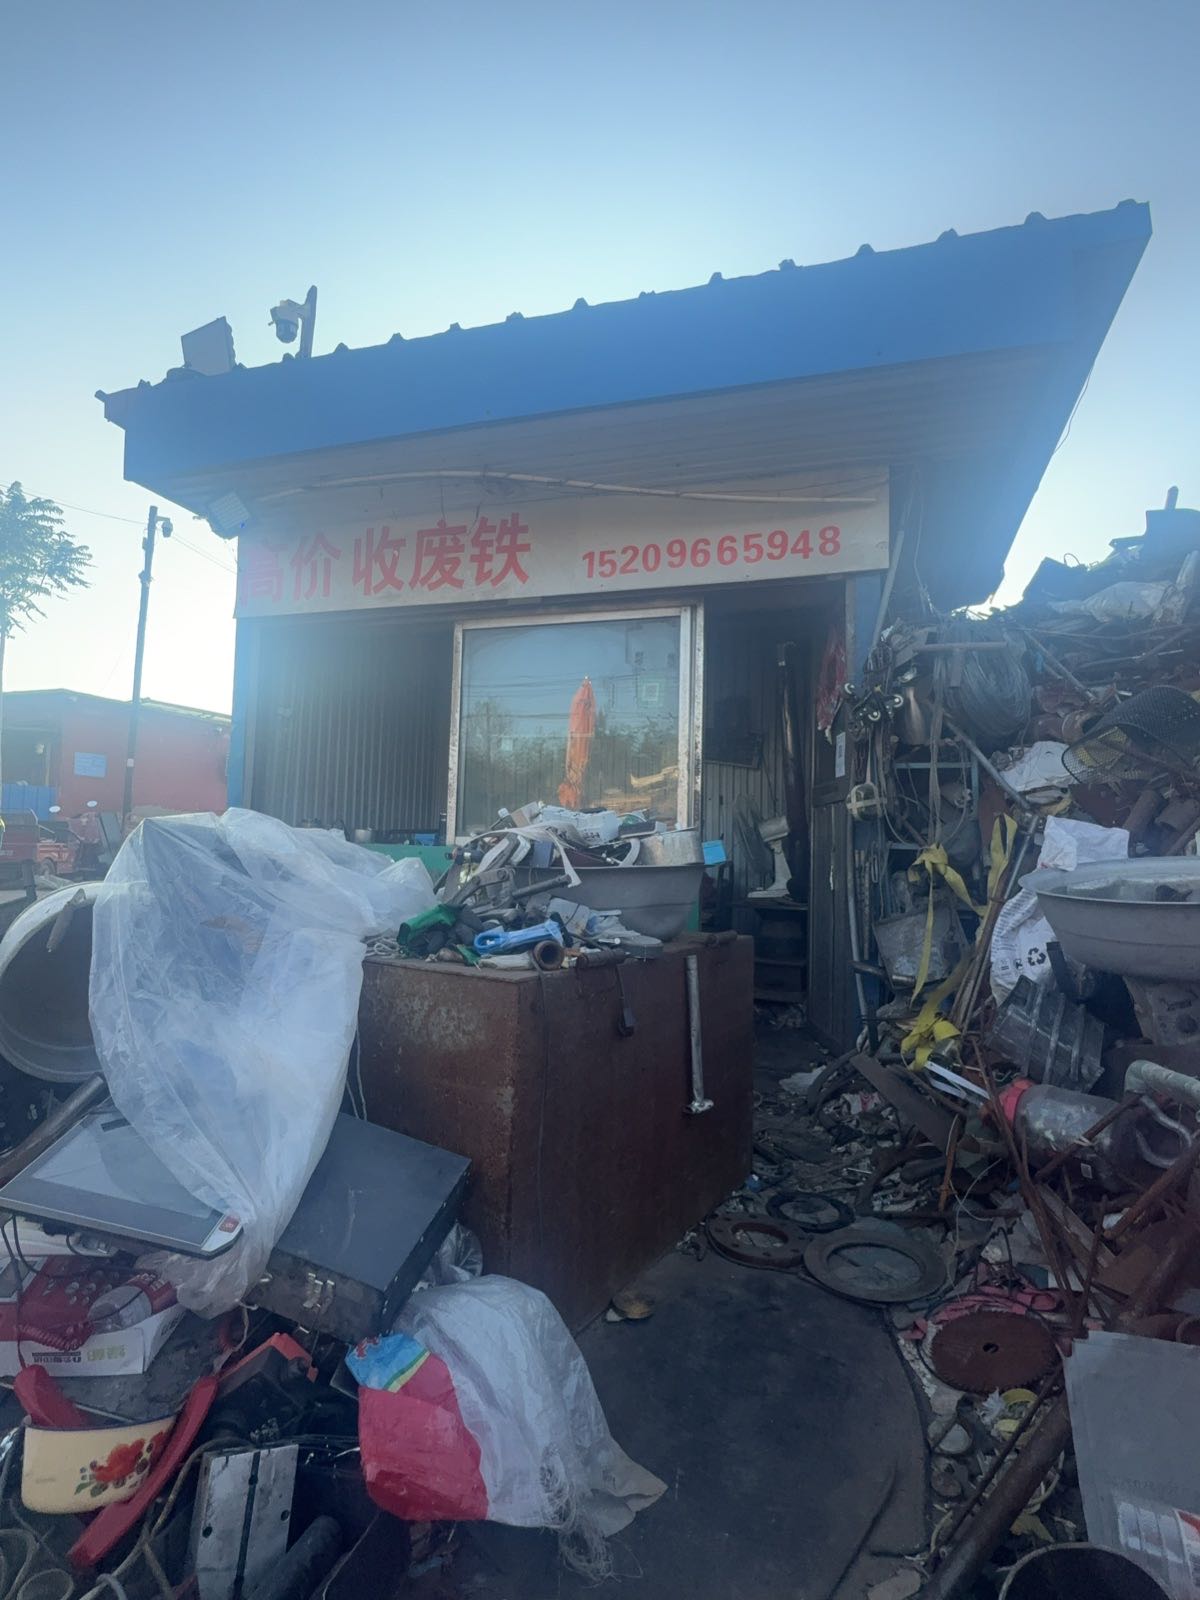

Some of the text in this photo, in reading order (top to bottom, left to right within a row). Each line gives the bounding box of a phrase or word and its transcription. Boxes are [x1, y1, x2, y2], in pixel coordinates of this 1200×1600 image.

[241, 512, 531, 606] 高价收废铁
[582, 526, 841, 578] 15209665948
